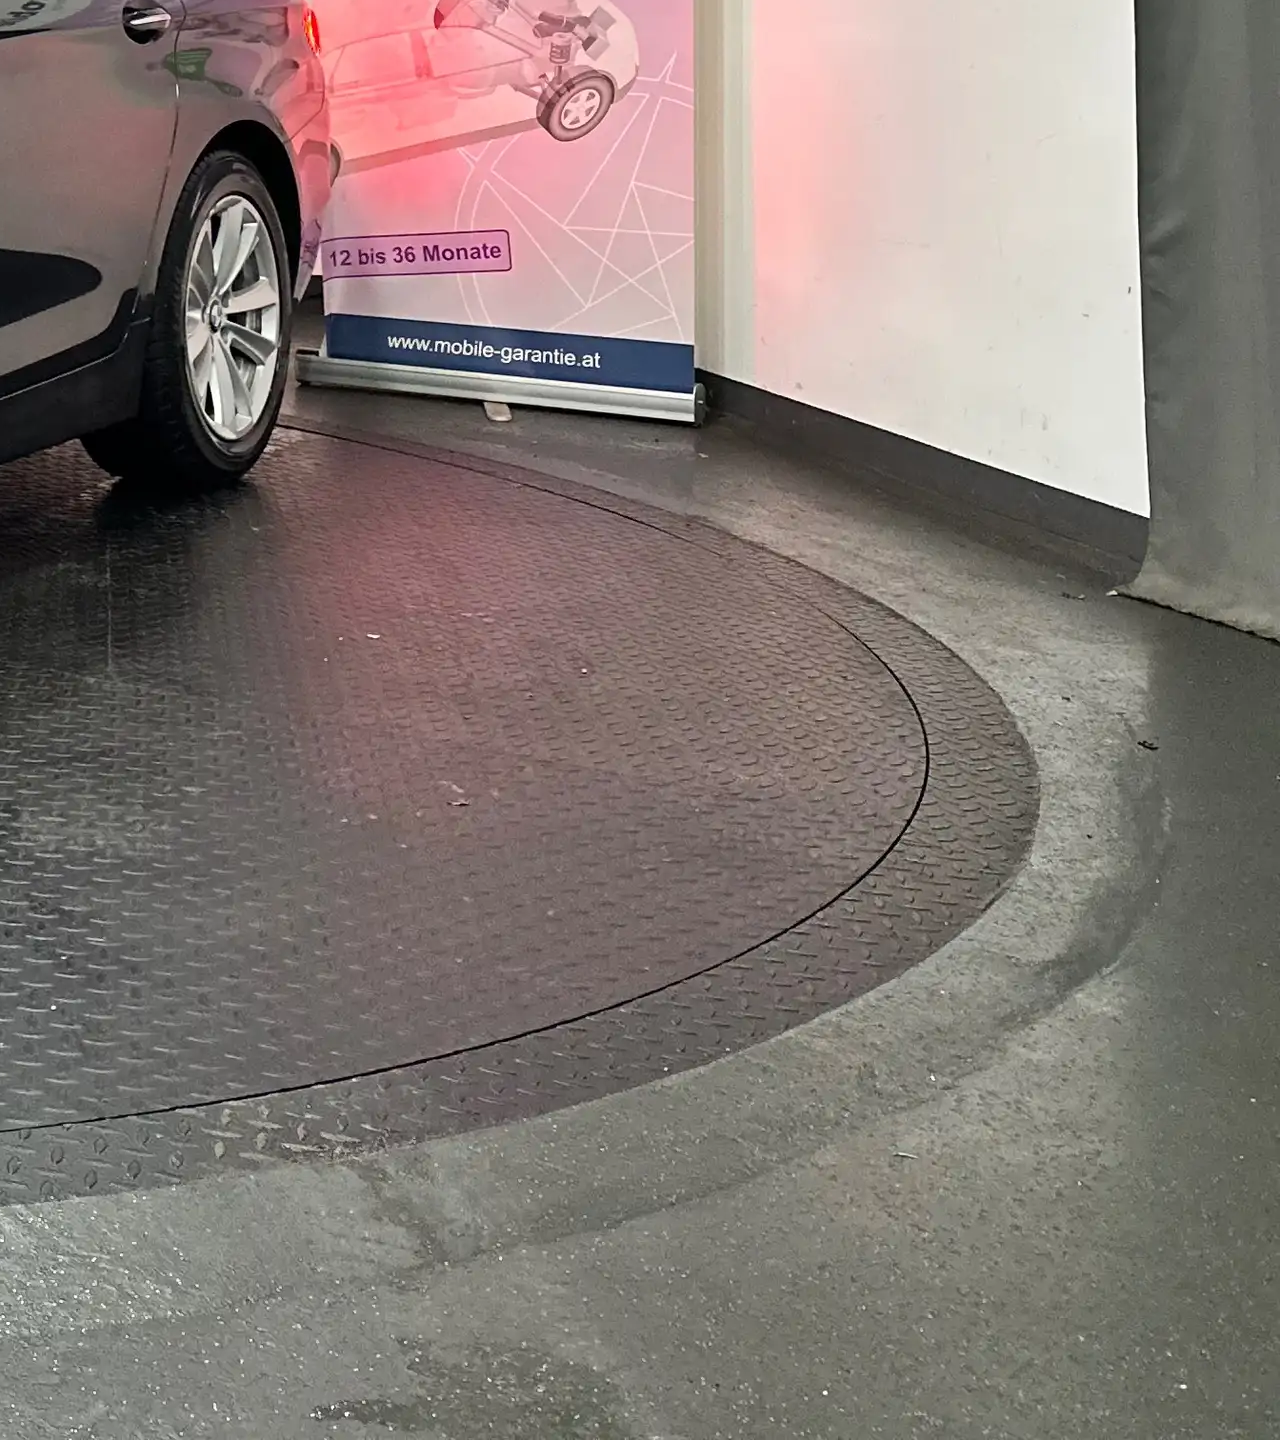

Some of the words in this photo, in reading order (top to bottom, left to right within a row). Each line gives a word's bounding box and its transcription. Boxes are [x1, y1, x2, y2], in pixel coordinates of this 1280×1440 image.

[330, 250, 352, 267] 12
[358, 248, 386, 265] bis
[393, 246, 415, 263] 36
[423, 243, 501, 262] Monate
[387, 334, 601, 369] www.mobile-garantie.at
